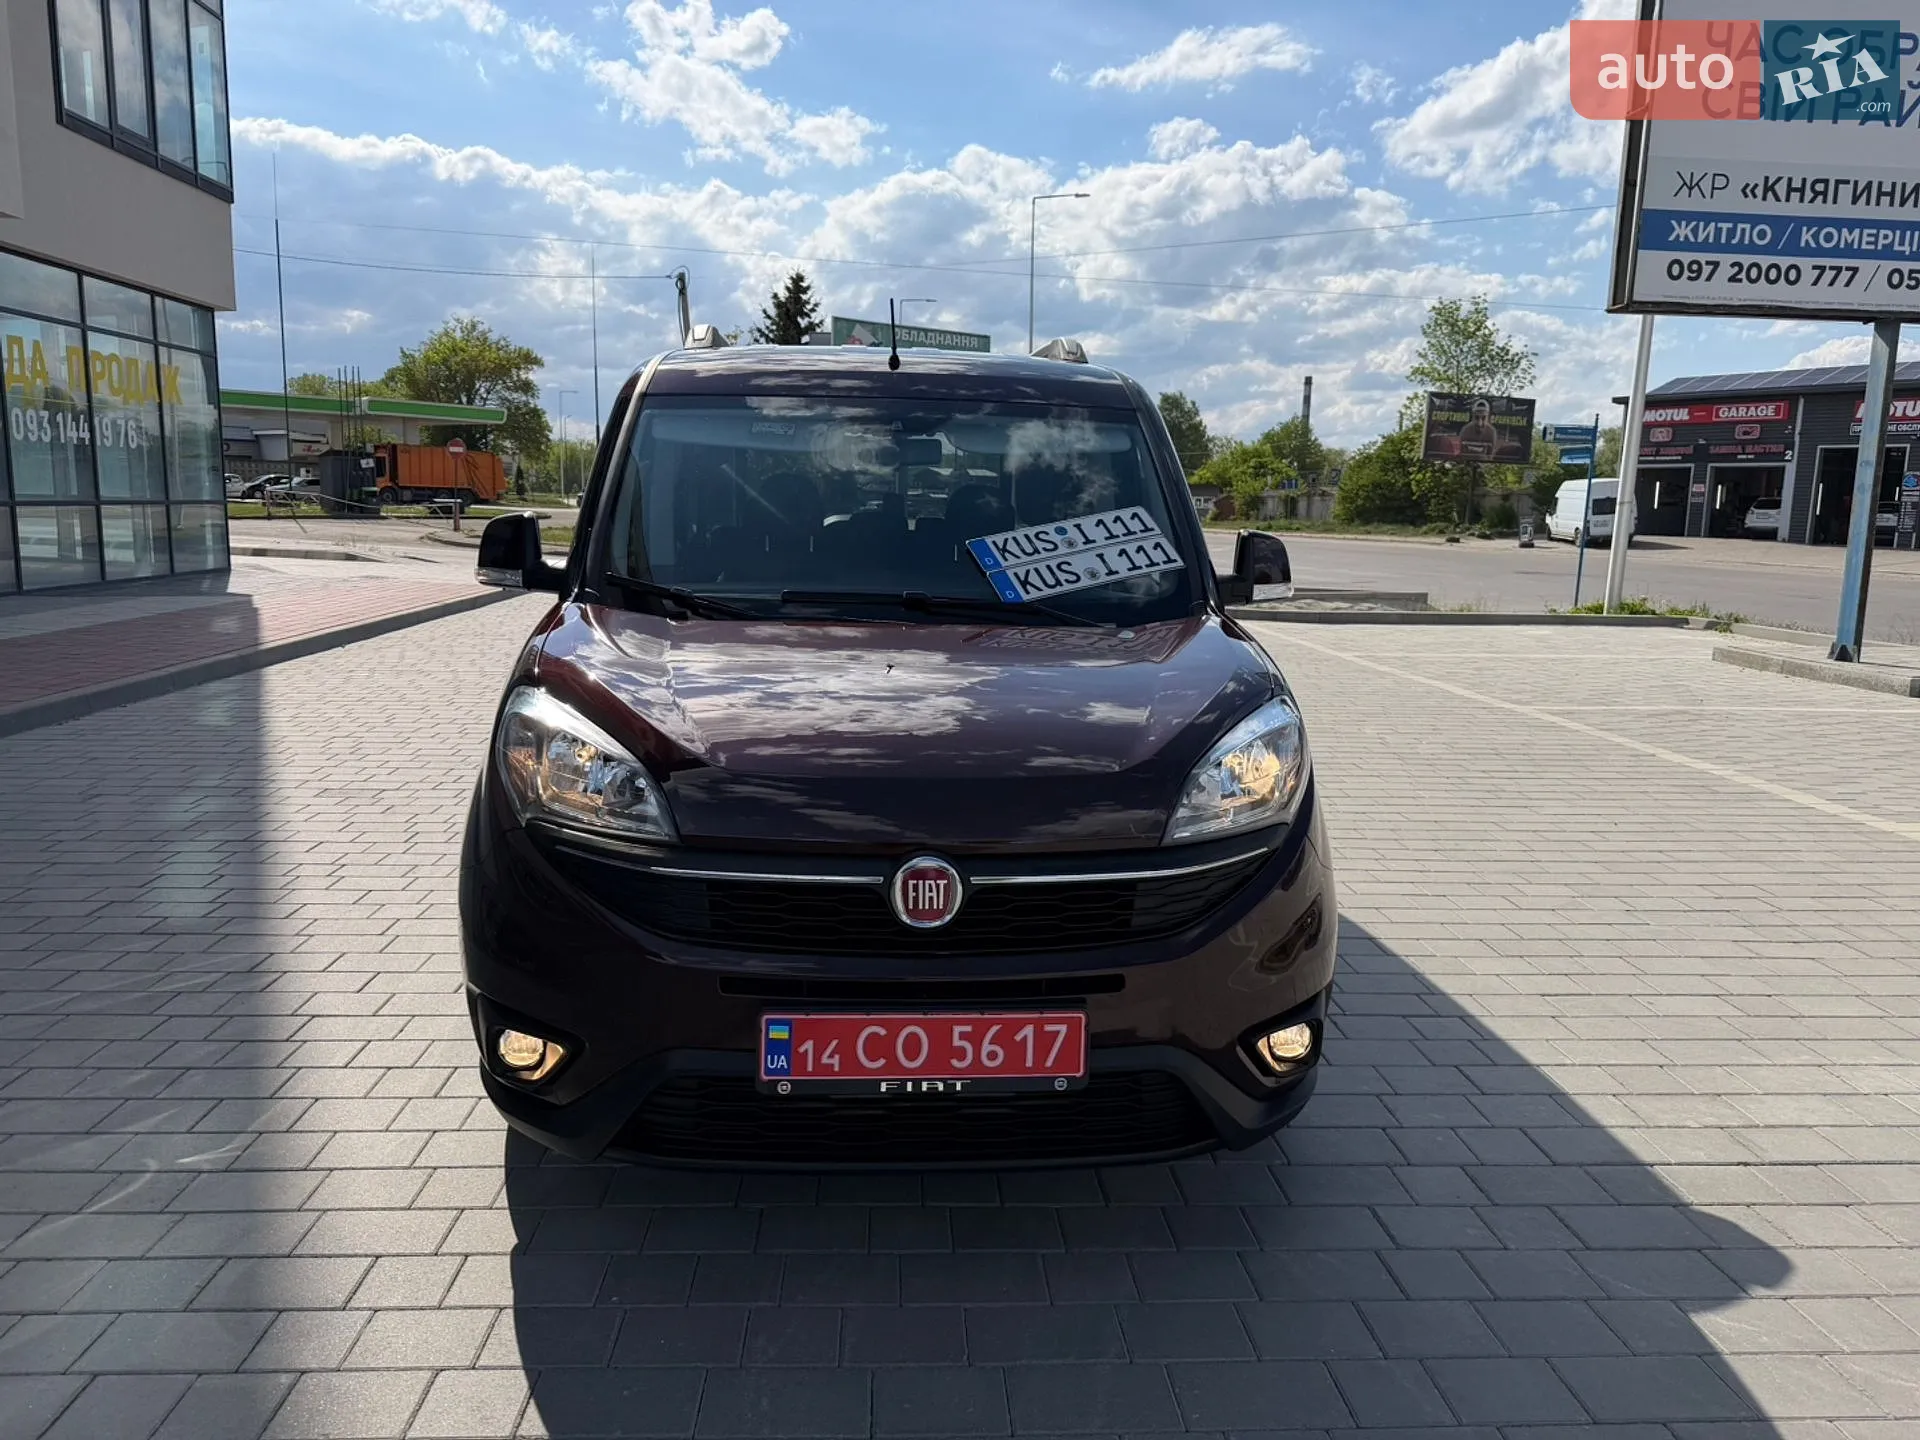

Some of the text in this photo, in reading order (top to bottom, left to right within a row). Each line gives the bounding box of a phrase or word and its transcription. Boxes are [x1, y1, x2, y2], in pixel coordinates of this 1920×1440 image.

[1820, 27, 1920, 71] ОБР
[1673, 170, 1920, 208] ЖР «КНЯГИНИ
[1668, 220, 1772, 245] ЖИТЛО
[1666, 258, 1721, 282] 097
[1728, 261, 1802, 286] 2000
[1810, 265, 1859, 288] 777
[1887, 267, 1920, 291] 05
[6, 335, 48, 393] ДА
[11, 407, 51, 442] 093
[57, 412, 90, 445] 144
[1643, 406, 1776, 421] MOTUL GARAGE
[1784, 450, 1793, 460] 2
[992, 531, 1059, 562] KUS
[1013, 561, 1081, 595] KUS
[908, 879, 947, 909] FIAT
[767, 1055, 788, 1069] UA
[797, 1023, 1068, 1072] 14 CO 5617
[880, 1080, 971, 1092] FIAT
